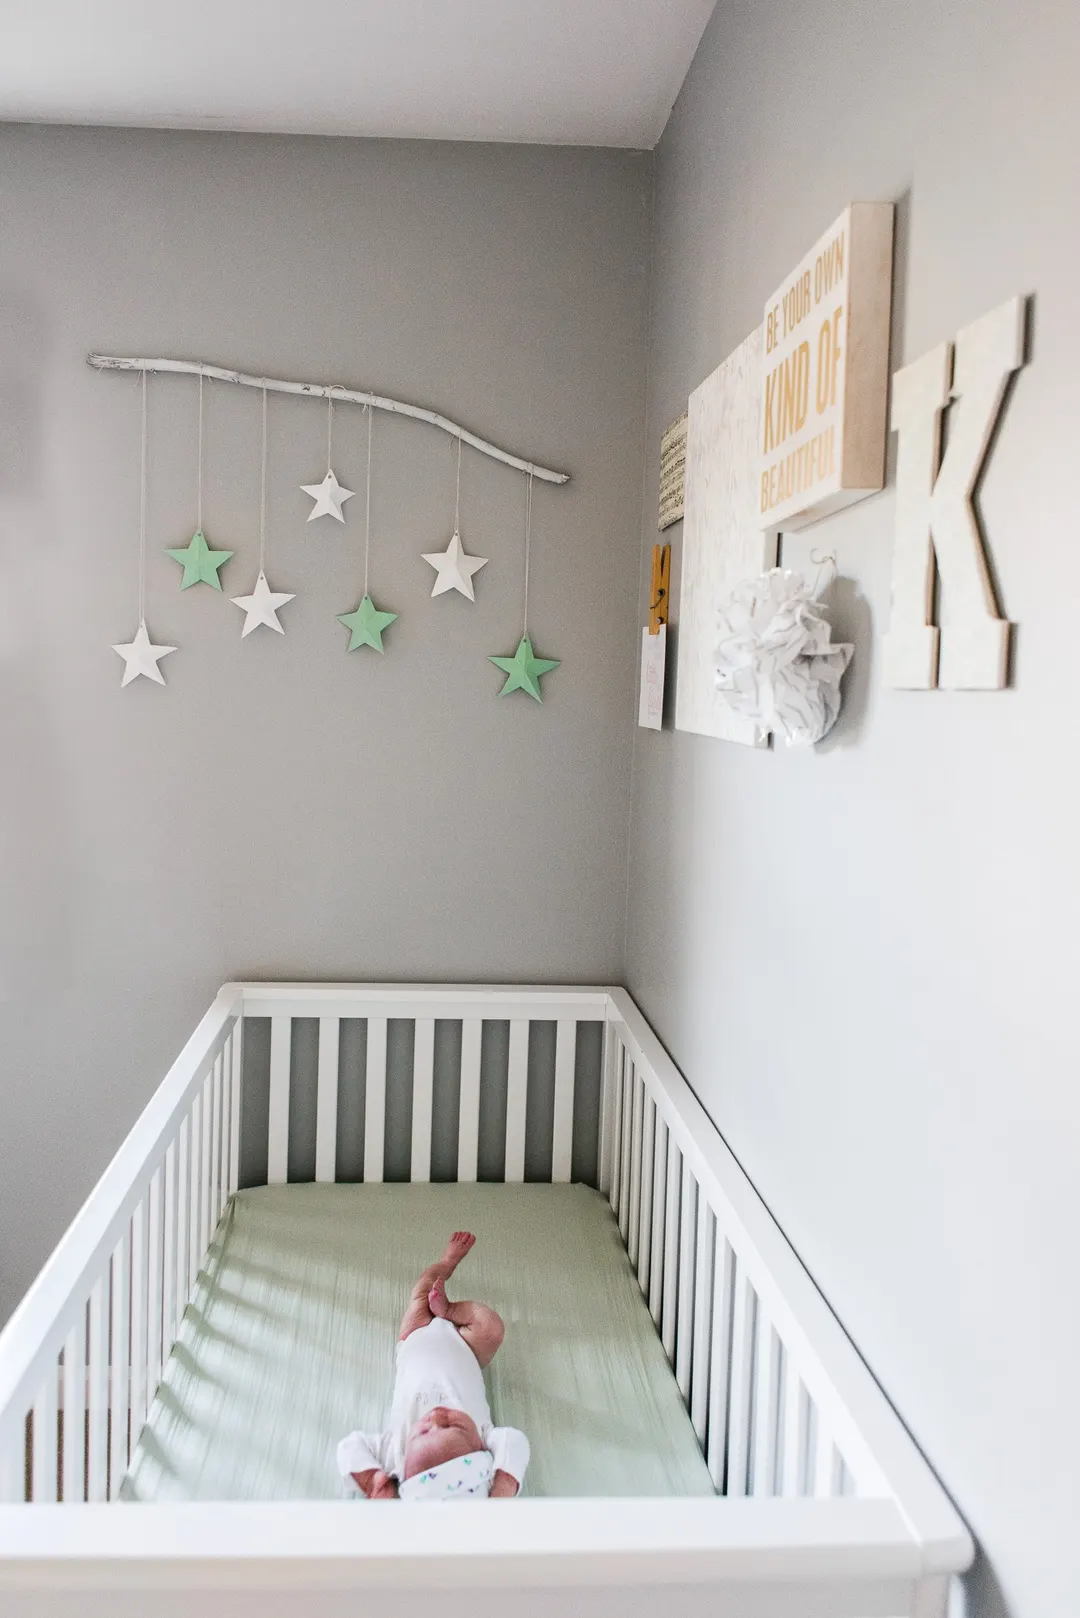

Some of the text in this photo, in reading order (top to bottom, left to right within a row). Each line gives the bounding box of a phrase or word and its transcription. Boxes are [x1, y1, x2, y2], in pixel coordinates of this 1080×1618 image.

[766, 231, 845, 356] BE YOUR OWN
[764, 305, 843, 456] KIND OF
[760, 424, 837, 515] BEAUTIFUL
[883, 293, 1028, 690] K
